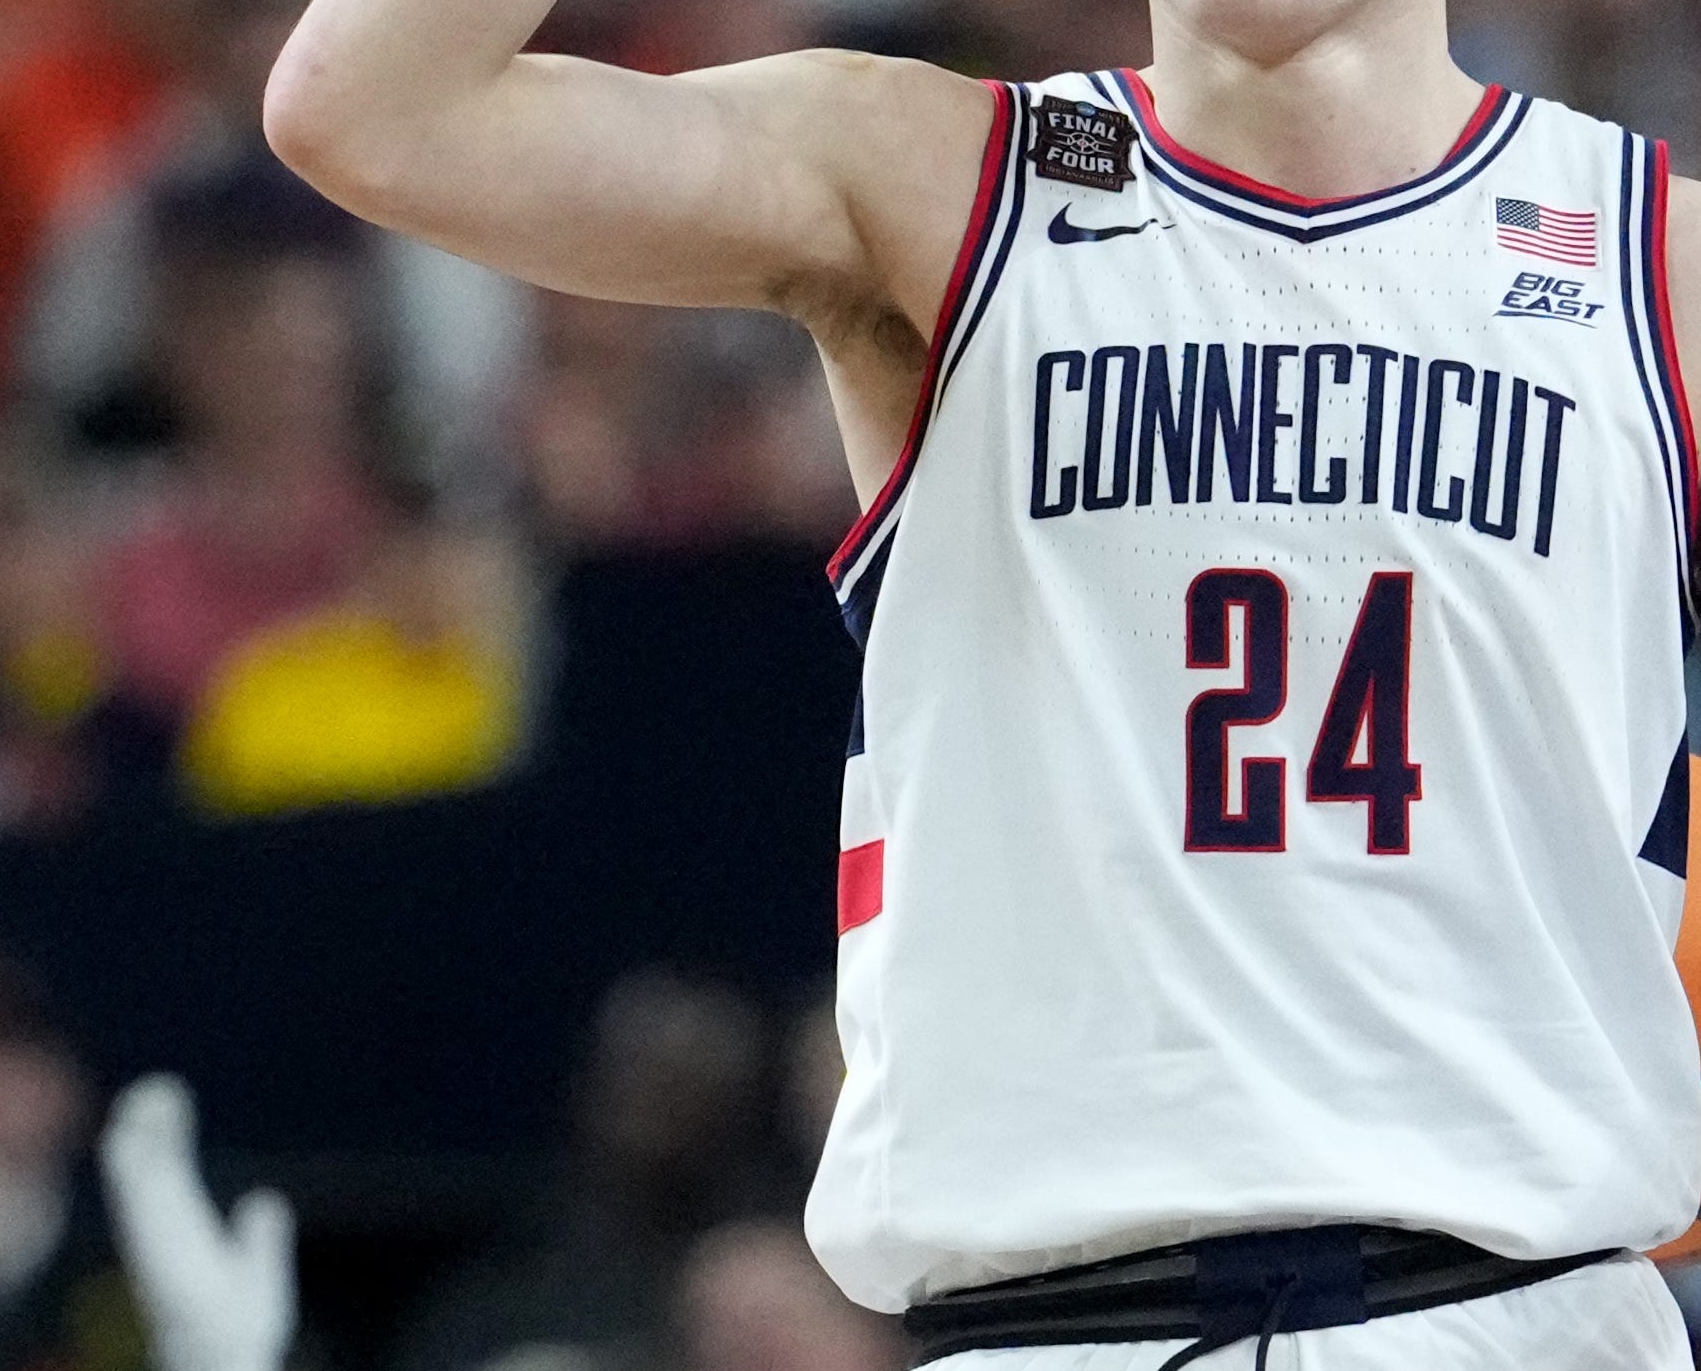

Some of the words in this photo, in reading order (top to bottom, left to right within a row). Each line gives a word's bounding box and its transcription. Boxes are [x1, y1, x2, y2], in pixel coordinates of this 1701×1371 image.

[1047, 111, 1119, 142] FINAL
[1046, 145, 1116, 174] FOUR
[1511, 271, 1586, 298] BIG
[1500, 290, 1606, 320] EAST
[1029, 341, 1577, 559] CONNECTICUT
[1183, 566, 1423, 855] 24
